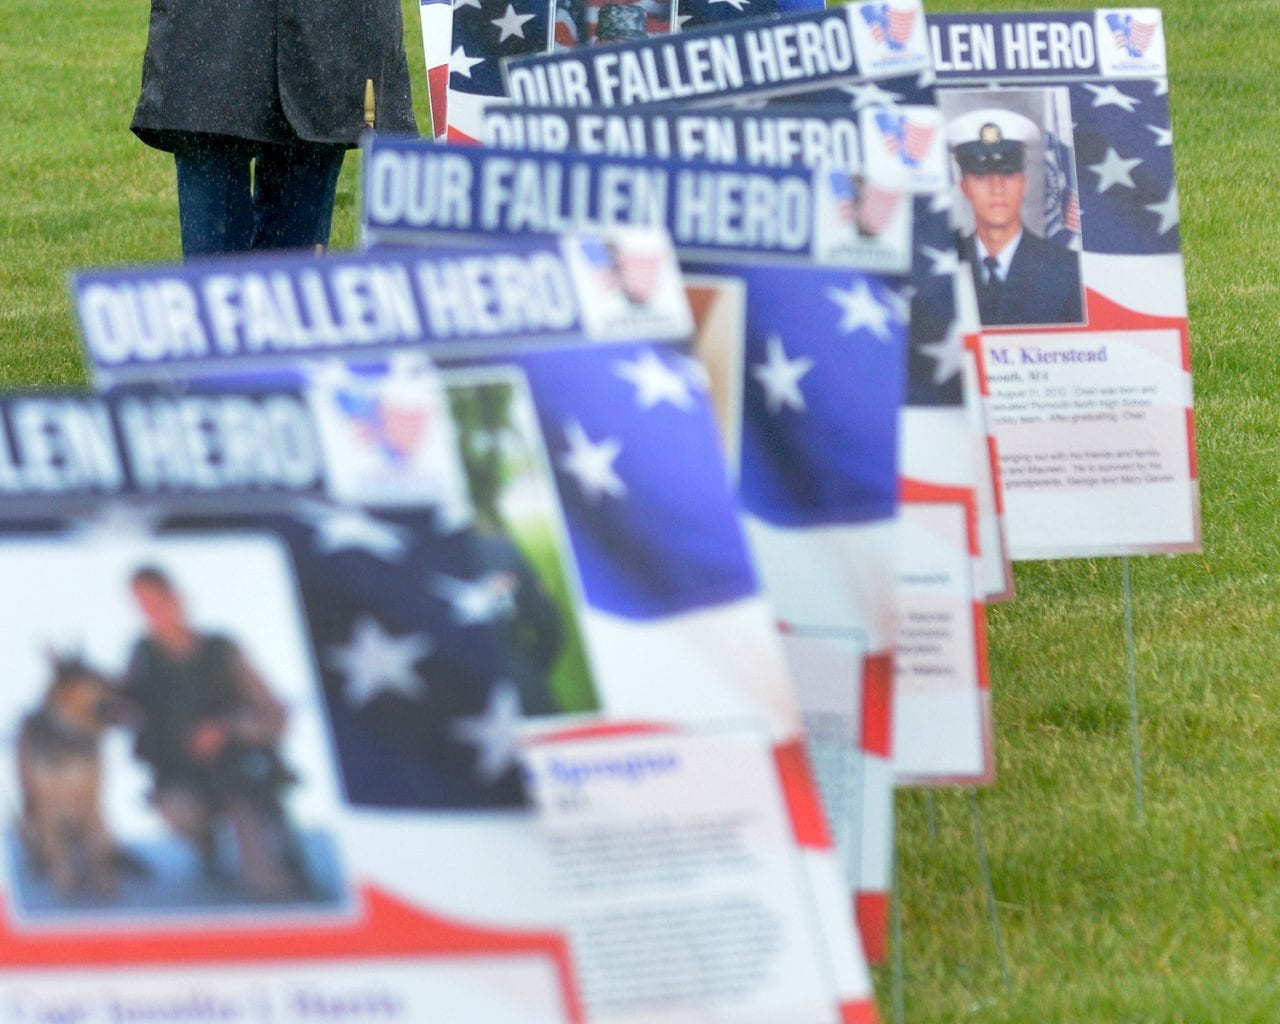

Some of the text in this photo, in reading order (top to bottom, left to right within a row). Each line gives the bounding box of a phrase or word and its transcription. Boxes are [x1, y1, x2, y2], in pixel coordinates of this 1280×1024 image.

[510, 17, 853, 107] OUR FALLEN HERO
[930, 21, 1095, 71] LEN HERO
[481, 113, 569, 152] OUR
[744, 116, 863, 174] HERO
[371, 150, 812, 250] OUR FALLEN HERO
[80, 250, 578, 364] OUR FALLEN HERO
[1019, 346, 1107, 365] Kierstead
[123, 399, 322, 493] HERO
